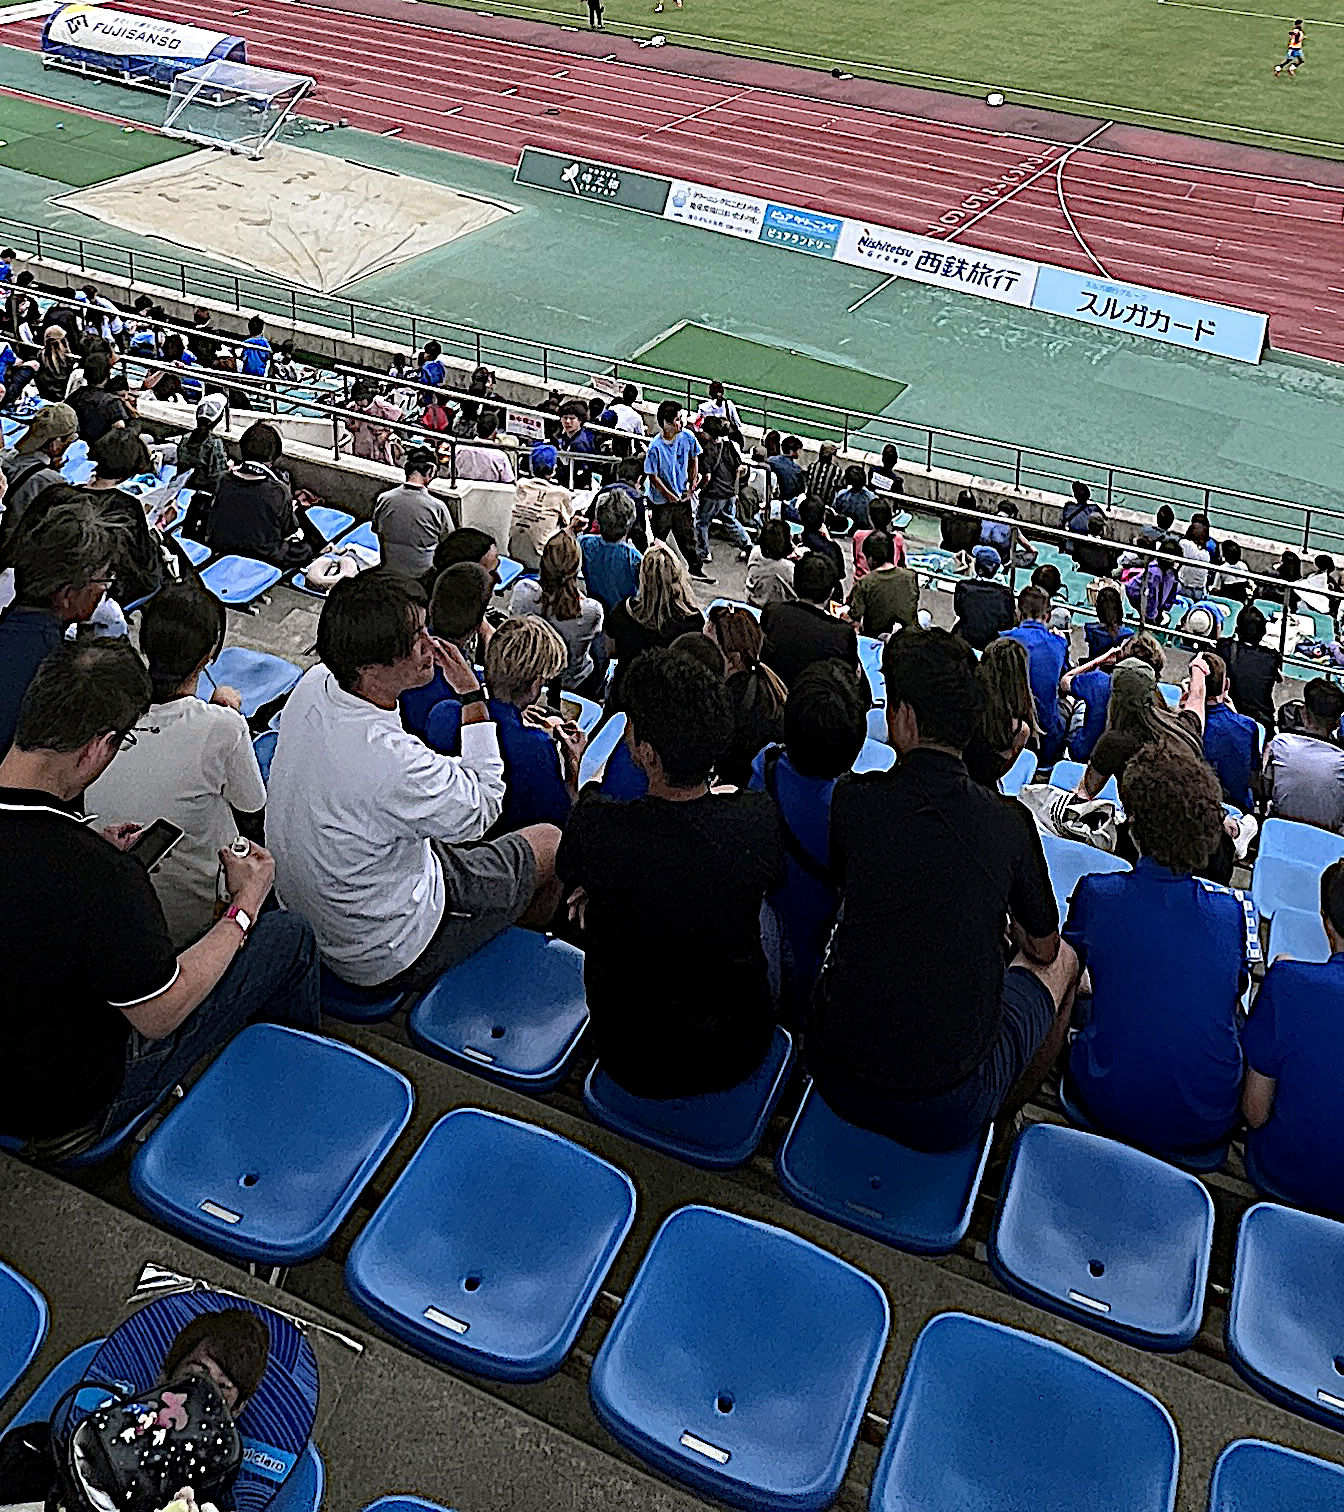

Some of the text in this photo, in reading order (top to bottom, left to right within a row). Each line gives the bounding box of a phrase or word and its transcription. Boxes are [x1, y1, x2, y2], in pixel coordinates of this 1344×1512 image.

[93, 22, 182, 50] FUJISANSO
[1018, 156, 1044, 170] 2
[961, 194, 989, 209] 5
[939, 209, 966, 224] 6
[767, 227, 832, 250] ピュアランドリー
[857, 235, 914, 258] Nishitetsu
[867, 250, 908, 266] Group
[914, 250, 1022, 292] 西鉄旅行
[1076, 291, 1216, 342] スルガカード
[252, 1452, 286, 1474] claro
